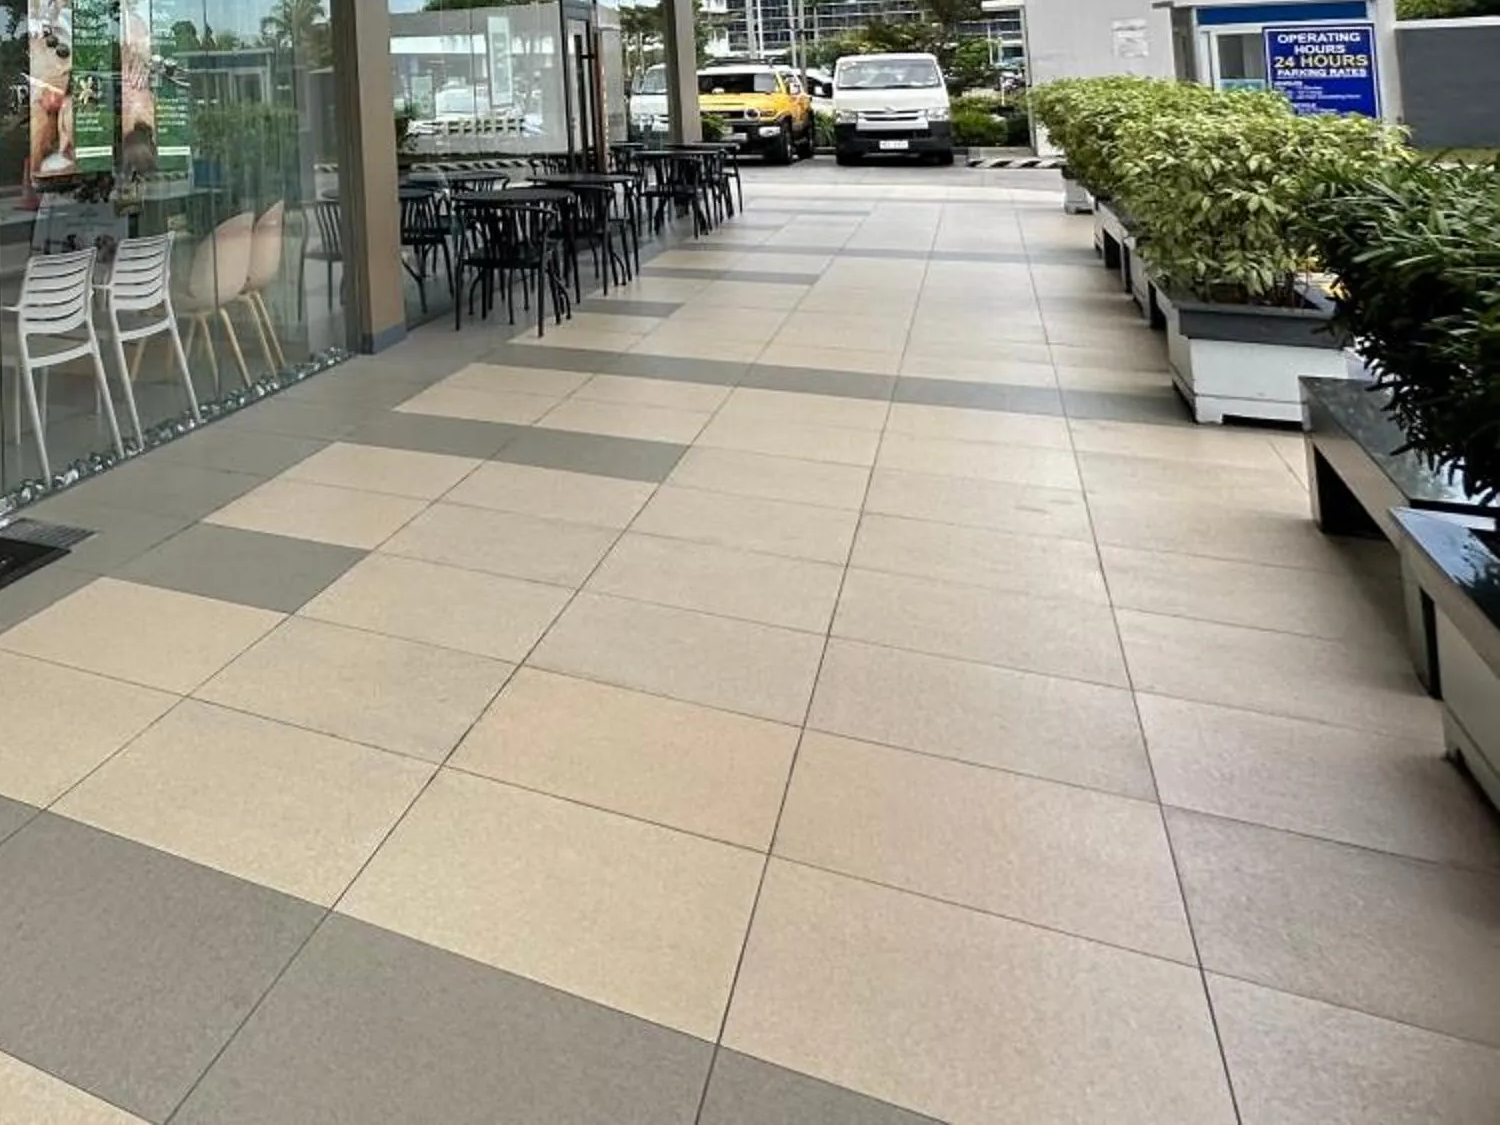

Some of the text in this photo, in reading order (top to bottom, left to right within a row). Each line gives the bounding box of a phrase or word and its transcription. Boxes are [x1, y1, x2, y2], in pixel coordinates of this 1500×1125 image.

[1277, 32, 1361, 44] OPERATING
[1294, 44, 1346, 55] HOURS
[1274, 54, 1369, 68] 24 HOURS
[1277, 68, 1367, 78] PARKING RATES
